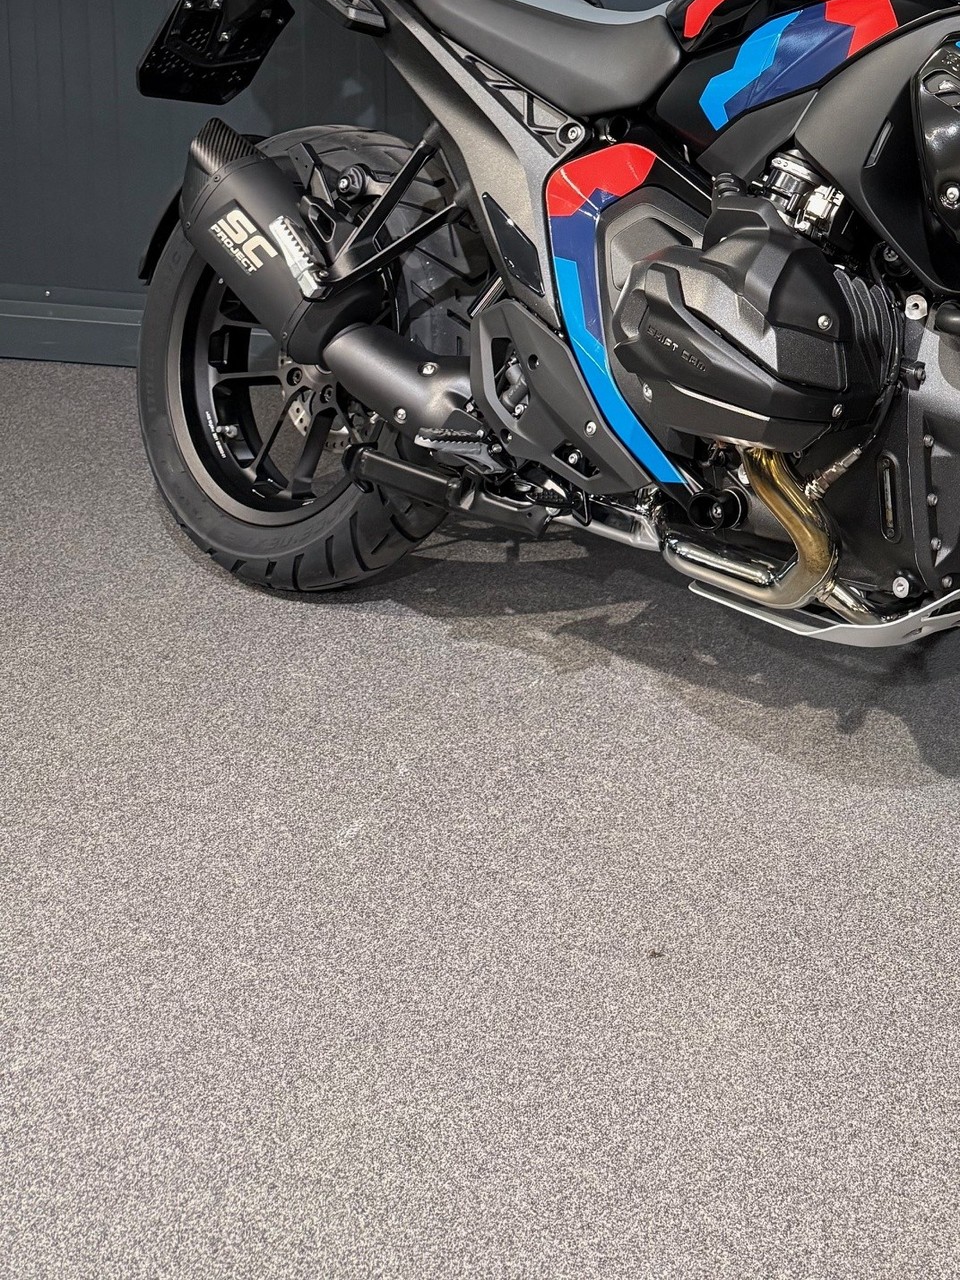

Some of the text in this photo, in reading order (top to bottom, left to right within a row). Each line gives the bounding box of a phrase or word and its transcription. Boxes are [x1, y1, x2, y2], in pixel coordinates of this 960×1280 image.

[210, 223, 257, 273] PROJECT
[217, 209, 279, 269] SC
[646, 325, 679, 352] SHIFT
